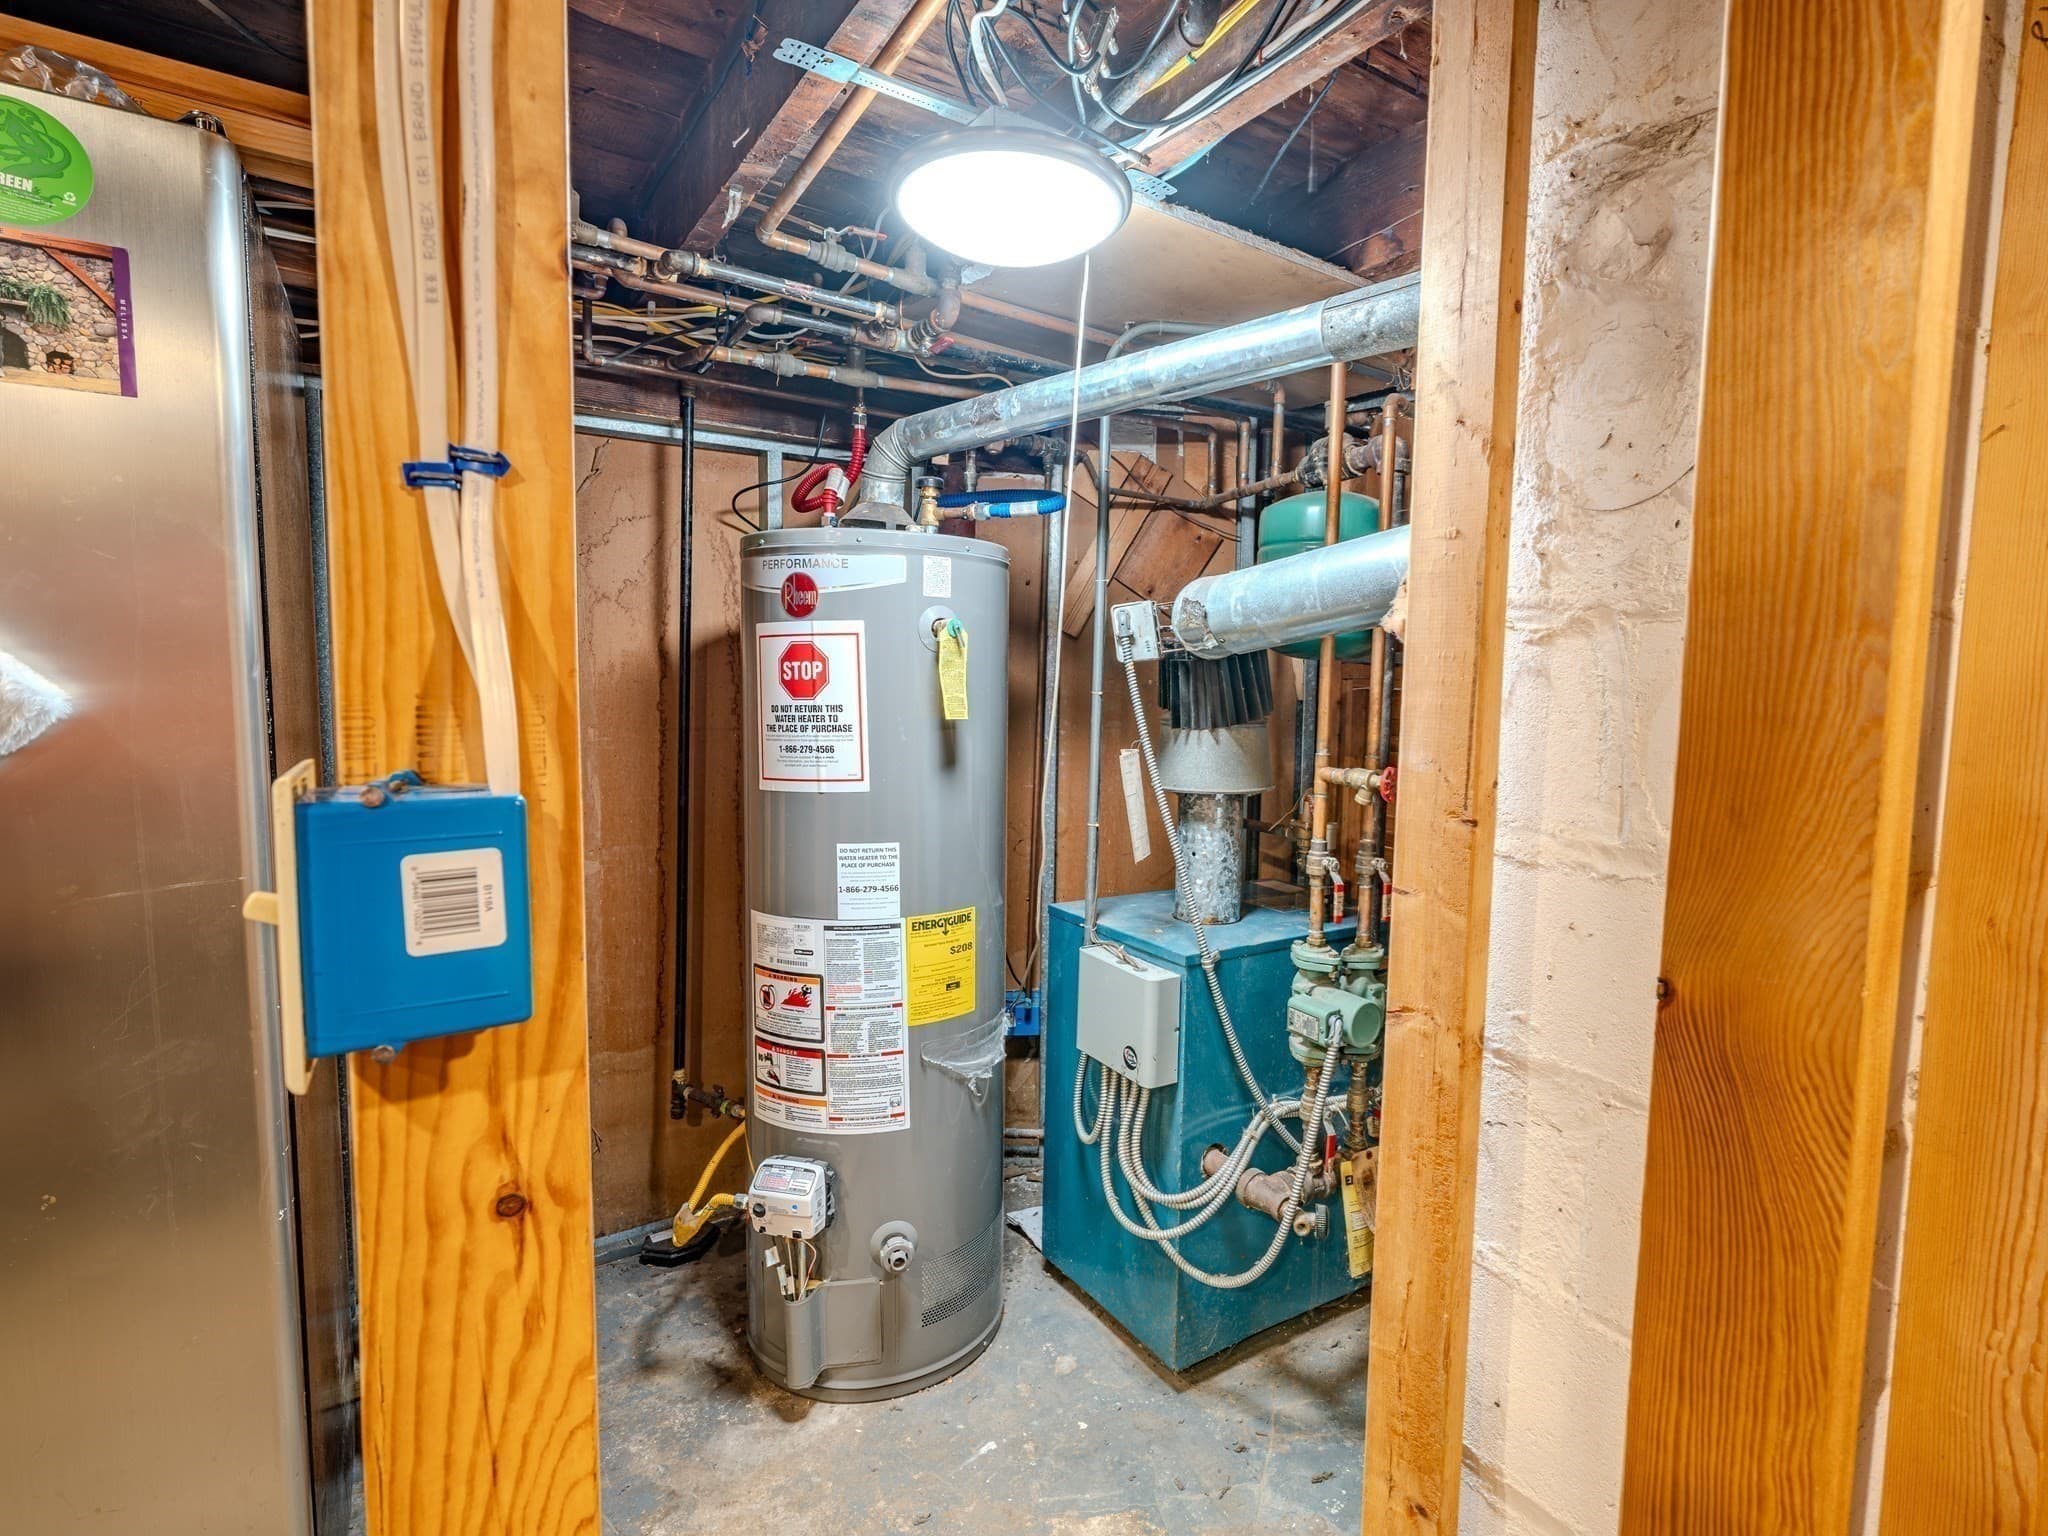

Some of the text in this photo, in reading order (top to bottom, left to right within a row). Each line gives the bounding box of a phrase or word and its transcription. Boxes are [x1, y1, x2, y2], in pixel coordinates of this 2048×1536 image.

[119, 298, 129, 340] MELISSA
[762, 558, 849, 570] PERFORMANCE
[783, 573, 818, 612] Rheem
[783, 660, 823, 681] STOP
[771, 704, 844, 713] DO NOT RETURN THIS
[774, 714, 839, 723] WATER HEATER TO
[766, 724, 853, 733] THE PLACE OF PURCHASE
[778, 745, 835, 754] 1-866-279-4566
[838, 884, 899, 894] 1-866-279-4566
[911, 912, 972, 932] ENERGYGUIDE
[949, 941, 973, 955] $208
